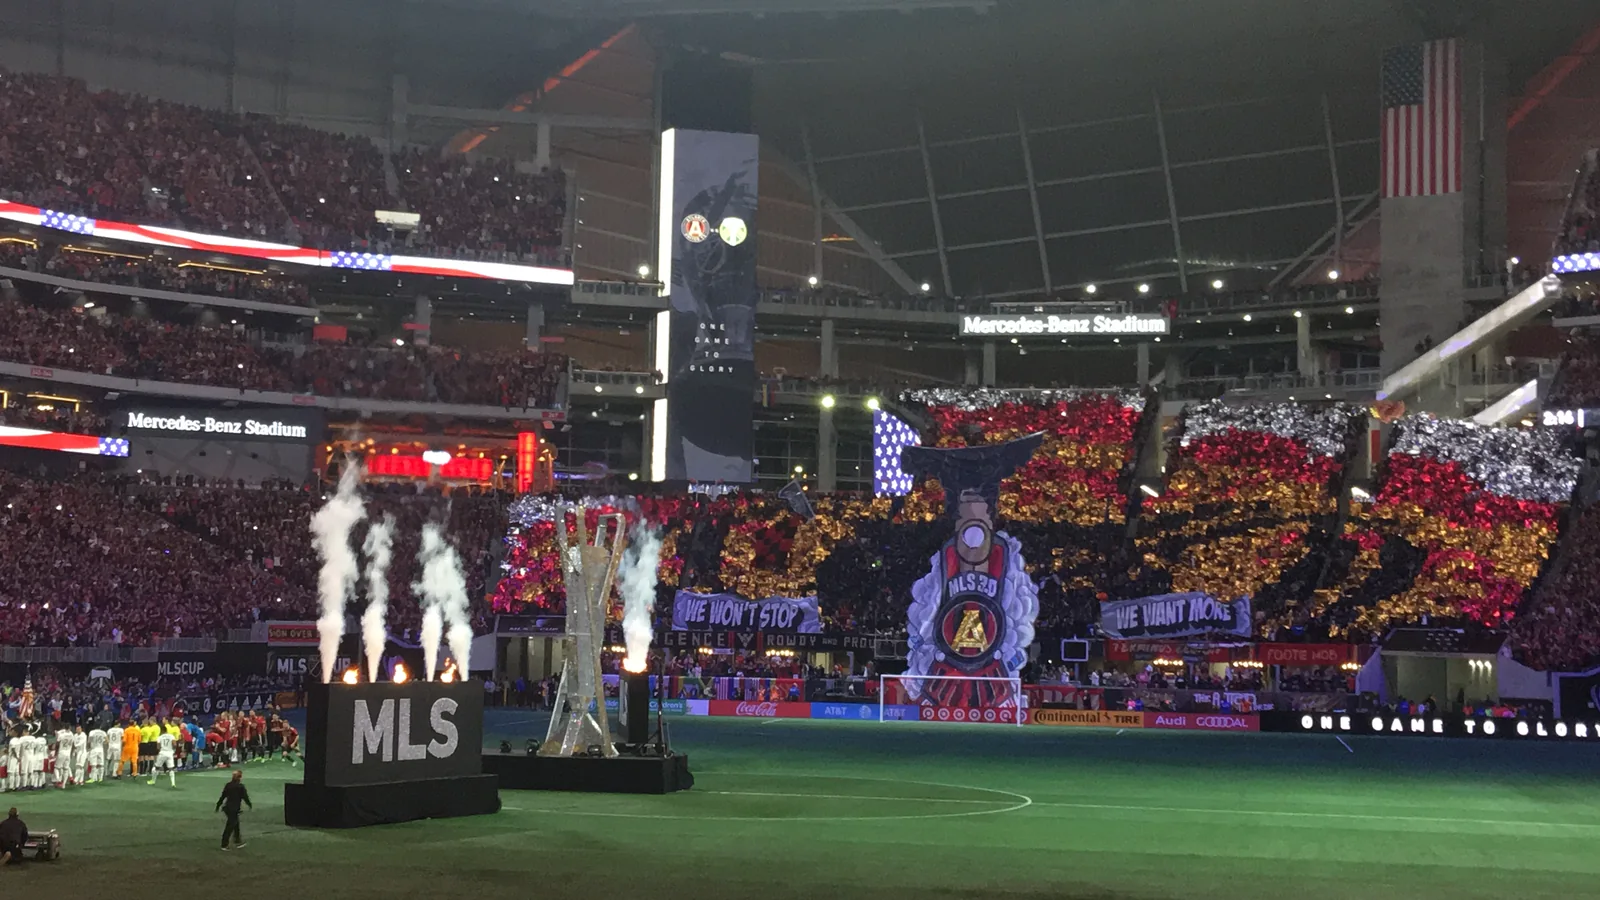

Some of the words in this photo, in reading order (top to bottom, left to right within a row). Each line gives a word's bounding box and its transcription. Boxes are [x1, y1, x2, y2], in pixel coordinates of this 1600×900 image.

[700, 322, 725, 331] ONE
[963, 315, 1090, 334] Mercedes-Benz
[1093, 314, 1166, 333] Stadium
[694, 336, 730, 345] GAME
[690, 364, 734, 373] GLORY
[128, 412, 241, 434] Mercedes-Benz
[244, 419, 307, 438] Stadium
[948, 573, 976, 598] MLS
[977, 576, 998, 598] 3.0
[685, 599, 707, 622] WE
[708, 600, 757, 627] WON'T
[759, 602, 800, 629] STOP
[1116, 604, 1139, 629] WE
[1142, 599, 1186, 627] WANT
[1188, 597, 1232, 622] MORE
[767, 634, 817, 647] ROWDY
[844, 635, 881, 649] PROU
[1267, 648, 1307, 661] FOOTE
[1312, 649, 1338, 661] MOB
[157, 661, 205, 675] MLSCUP
[277, 658, 307, 674] MLS
[824, 706, 848, 715] AT&T
[883, 708, 906, 717] AT&T
[1033, 709, 1101, 725] Continental
[1114, 715, 1141, 725] TIRE
[1155, 715, 1186, 726] Audi
[1301, 715, 1351, 730] ONE
[1371, 717, 1444, 733] GAME
[1464, 719, 1496, 734] TO
[351, 697, 459, 765] MLS
